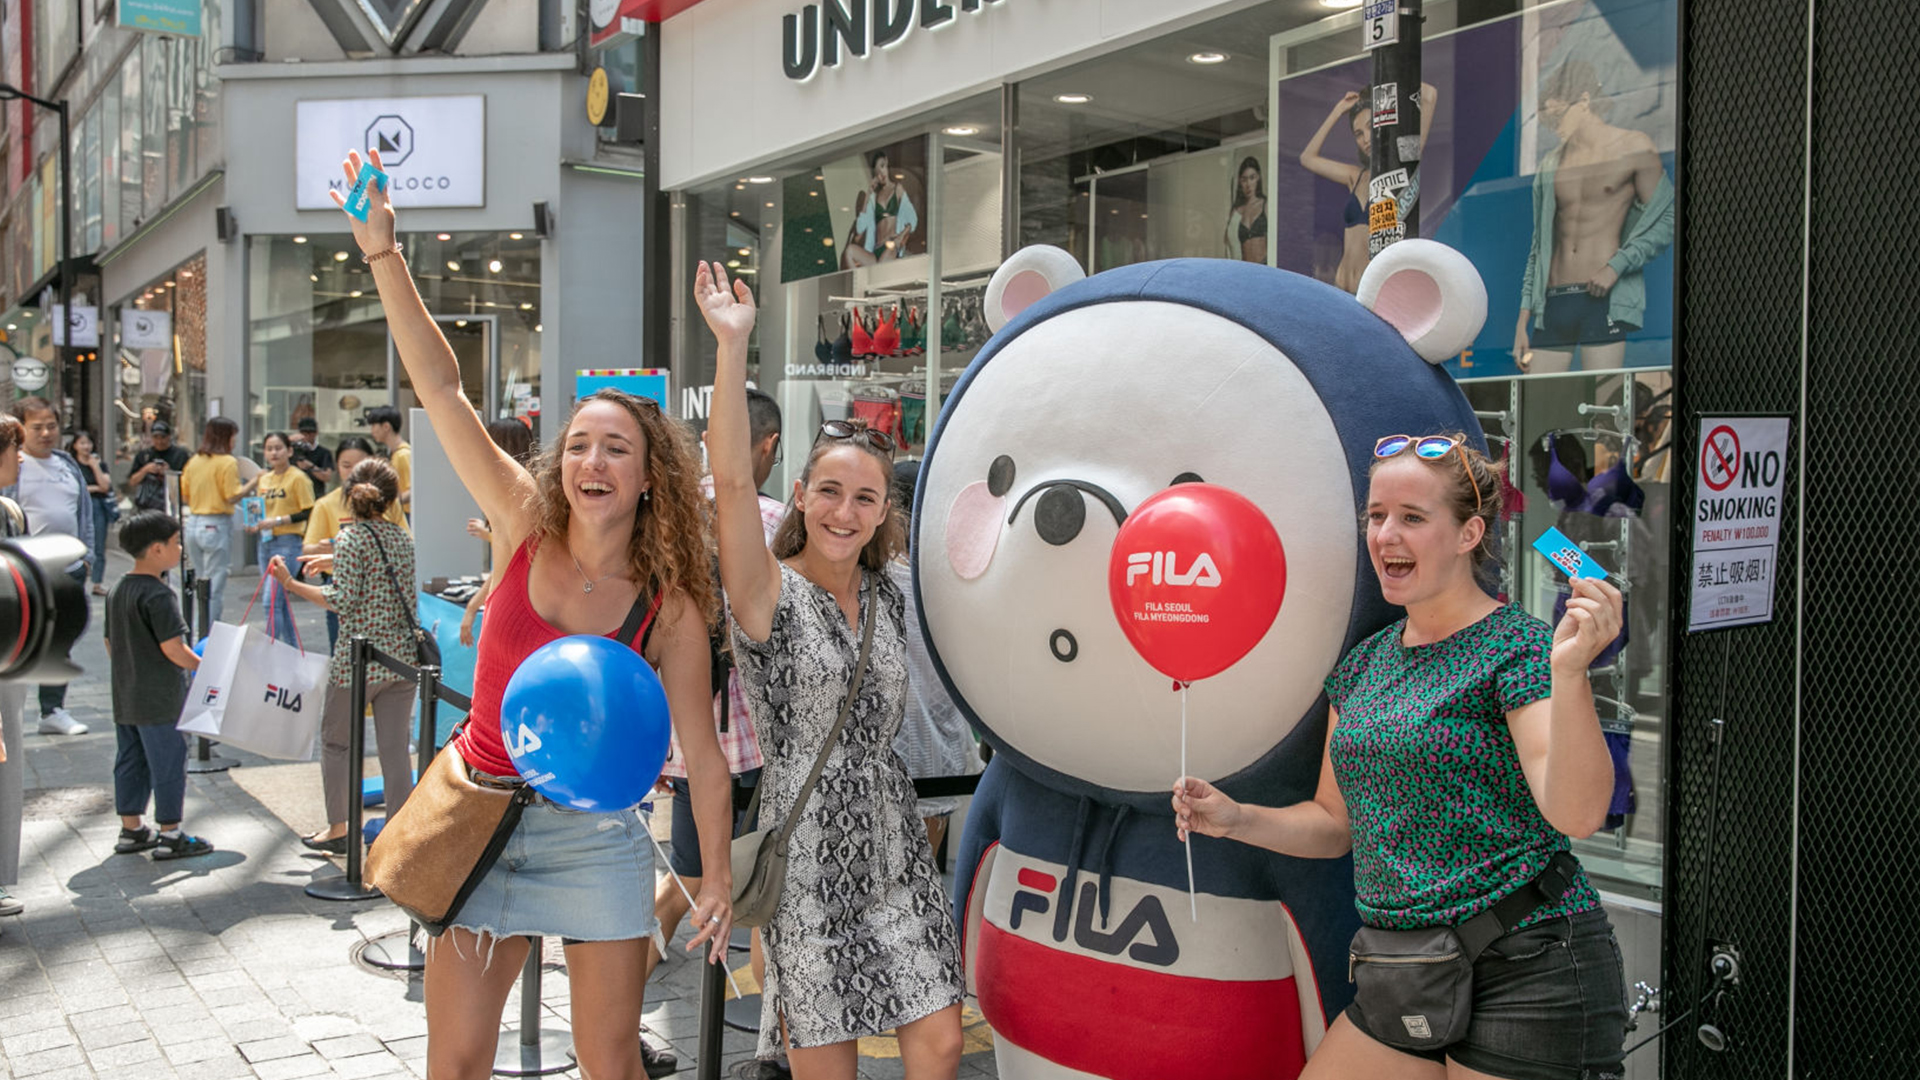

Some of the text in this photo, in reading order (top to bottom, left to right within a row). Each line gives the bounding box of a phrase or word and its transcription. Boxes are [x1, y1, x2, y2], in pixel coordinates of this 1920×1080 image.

[1373, 17, 1383, 40] 5
[1741, 450, 1780, 489] NO
[1698, 496, 1776, 522] SMOKING
[1702, 528, 1732, 543] PENALTY
[1126, 551, 1222, 588] FILA
[1134, 612, 1209, 623] FILA MYEONGDONG
[1145, 602, 1193, 612] FILA SEOUL
[264, 683, 302, 713] FILA
[1010, 867, 1180, 967] FILA
